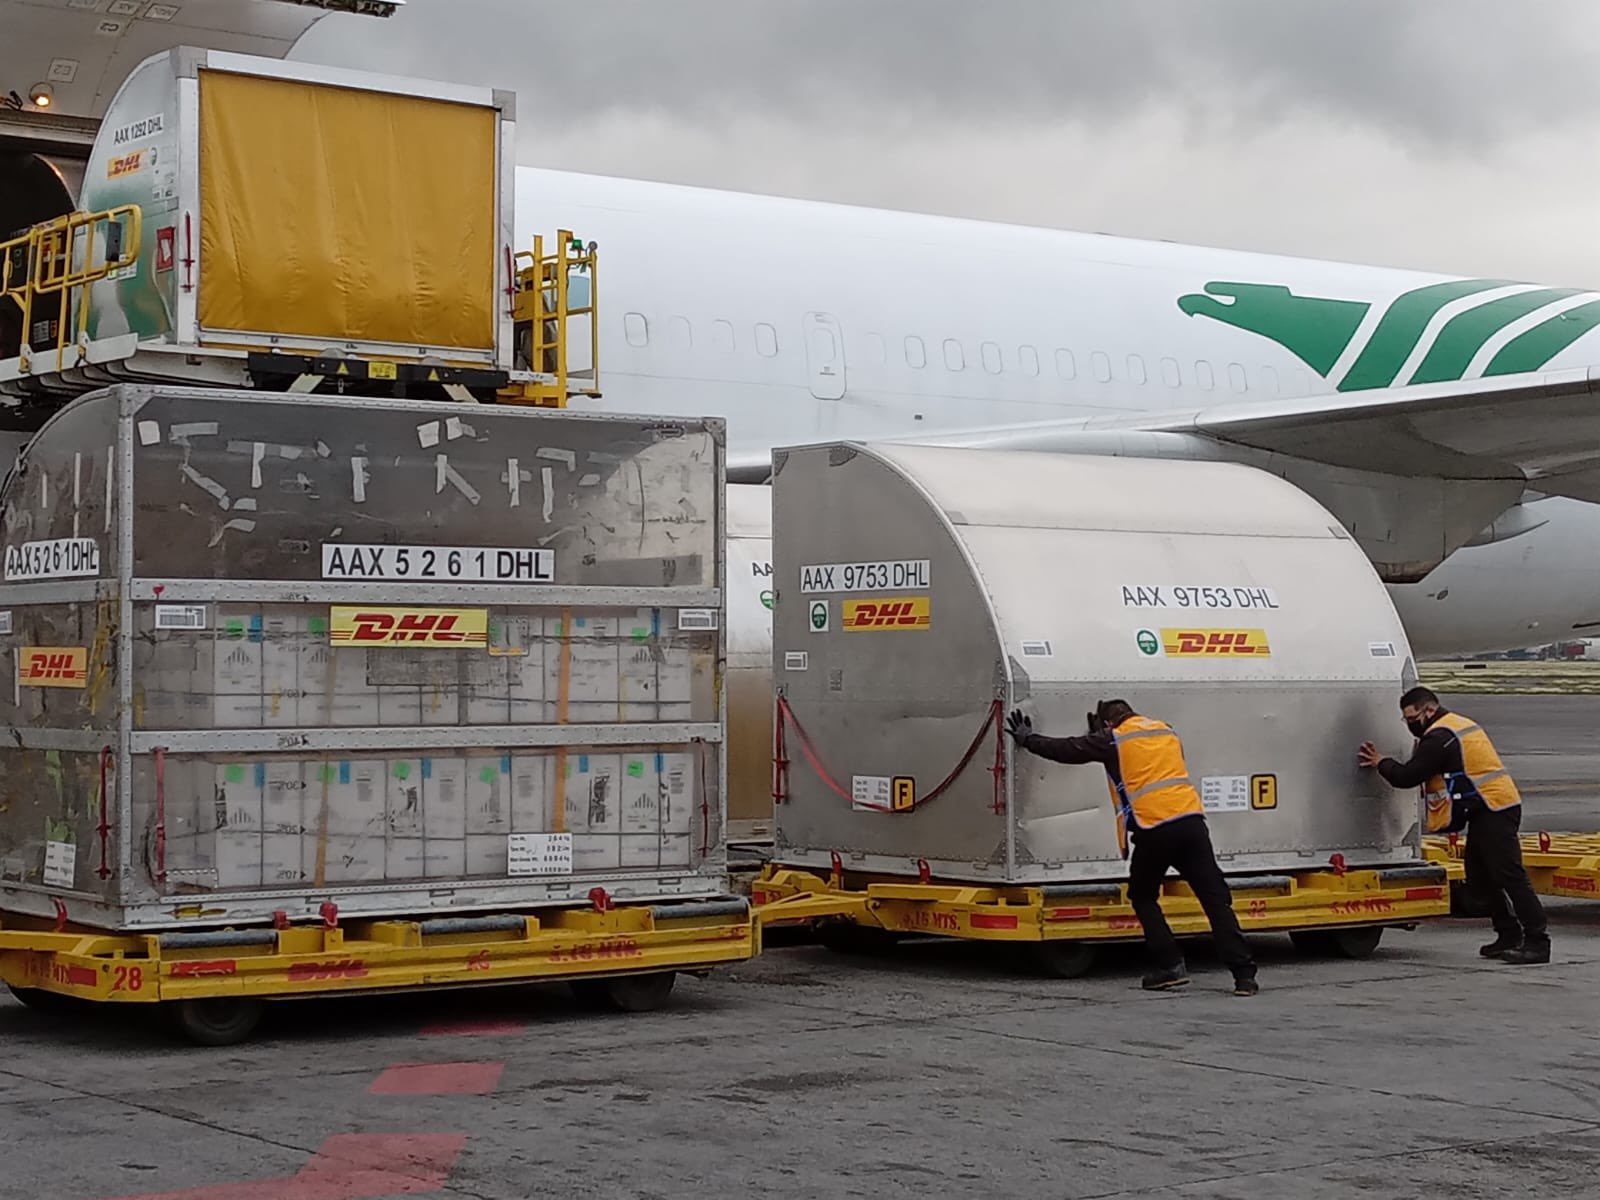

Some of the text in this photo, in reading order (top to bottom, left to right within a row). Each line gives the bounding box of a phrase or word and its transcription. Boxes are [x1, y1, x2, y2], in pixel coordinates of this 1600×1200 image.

[114, 127, 130, 145] AAX
[802, 562, 928, 591] AAX 9753 DHL
[1122, 585, 1280, 609] AAX 9753 DHL
[352, 612, 465, 642] DHL
[854, 603, 917, 627] DHL
[1177, 632, 1256, 654] DHL
[29, 653, 77, 679] DHL
[899, 783, 909, 806] F
[1258, 780, 1270, 804] F
[112, 965, 143, 992] 28
